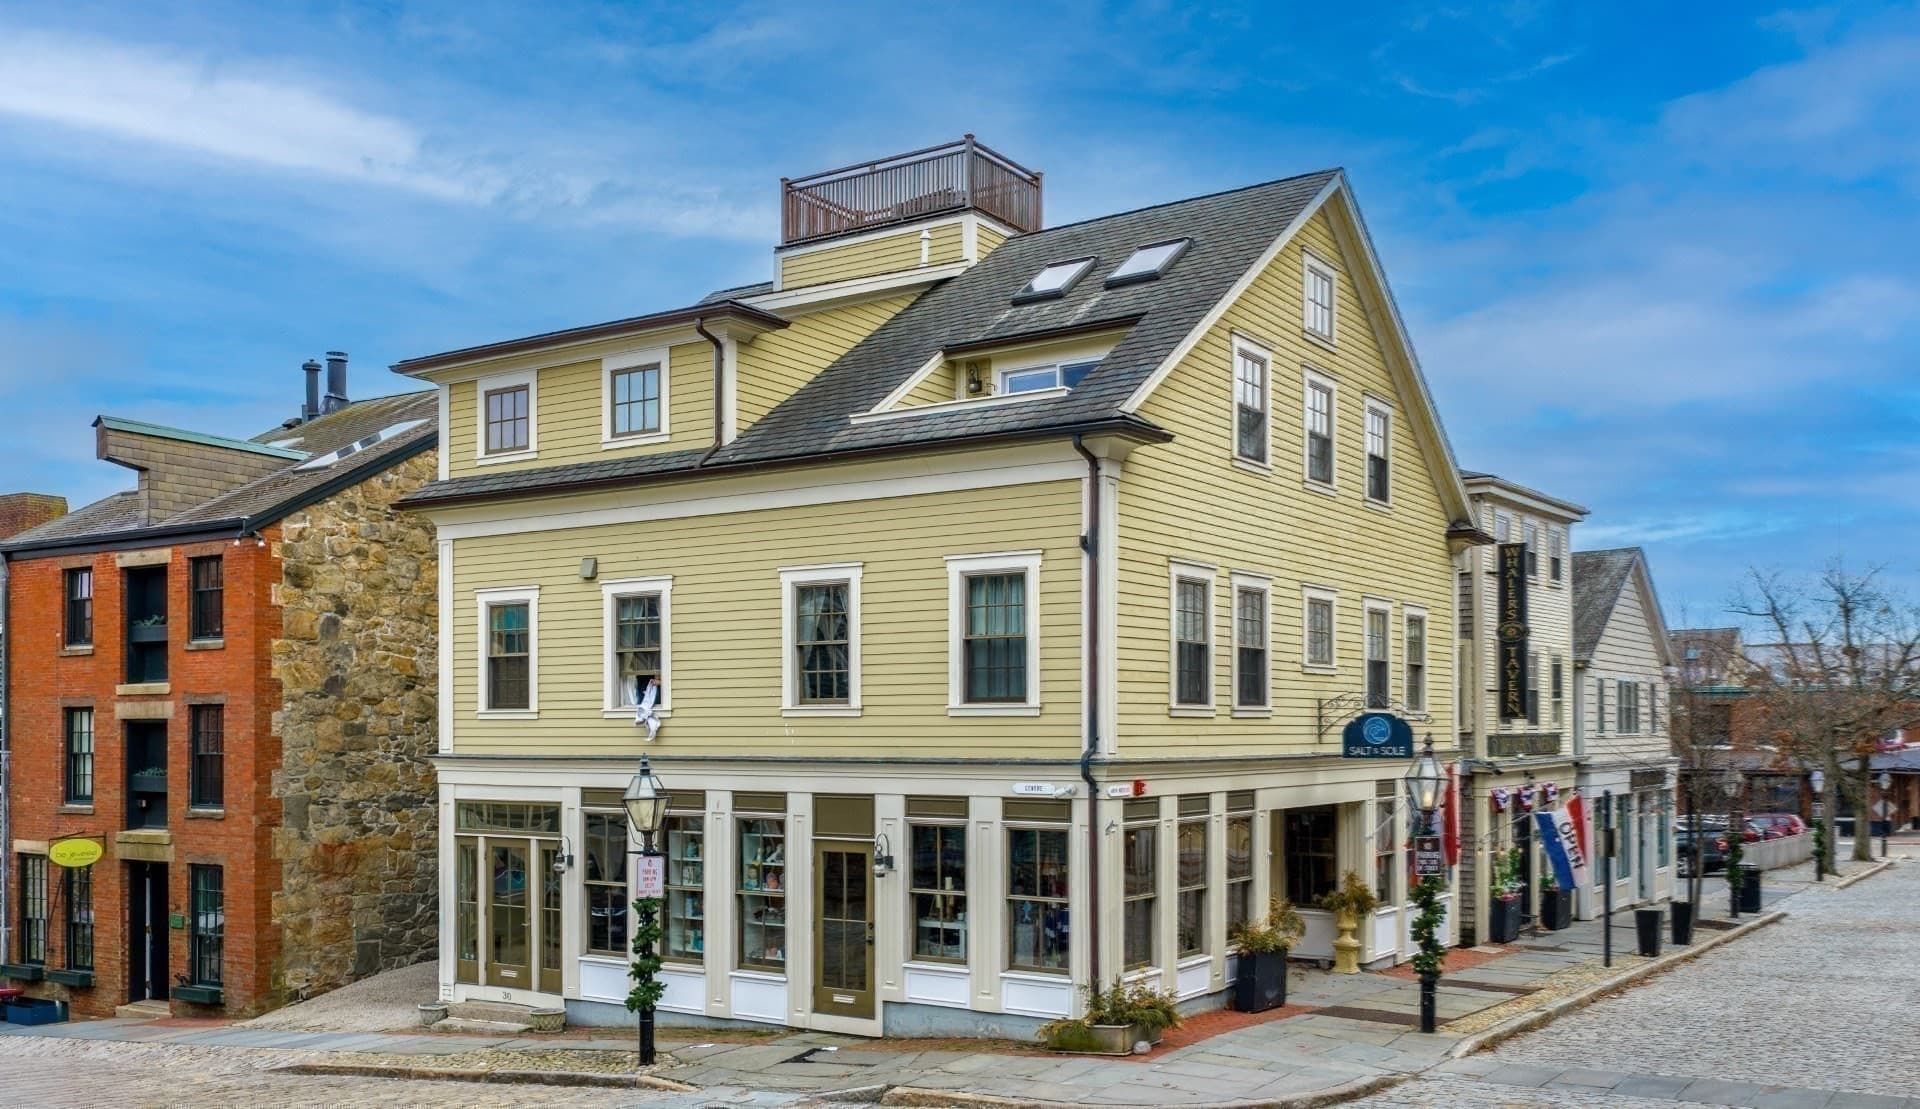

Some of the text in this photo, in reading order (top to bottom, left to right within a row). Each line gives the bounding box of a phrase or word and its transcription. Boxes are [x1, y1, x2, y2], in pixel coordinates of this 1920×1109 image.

[1503, 546, 1519, 620] WHALERS
[1504, 646, 1520, 713] TAVERN
[1349, 746, 1371, 756] SALT
[1380, 746, 1406, 756] SOLE
[1559, 821, 1584, 869] OPEN
[502, 991, 512, 1001] 30
